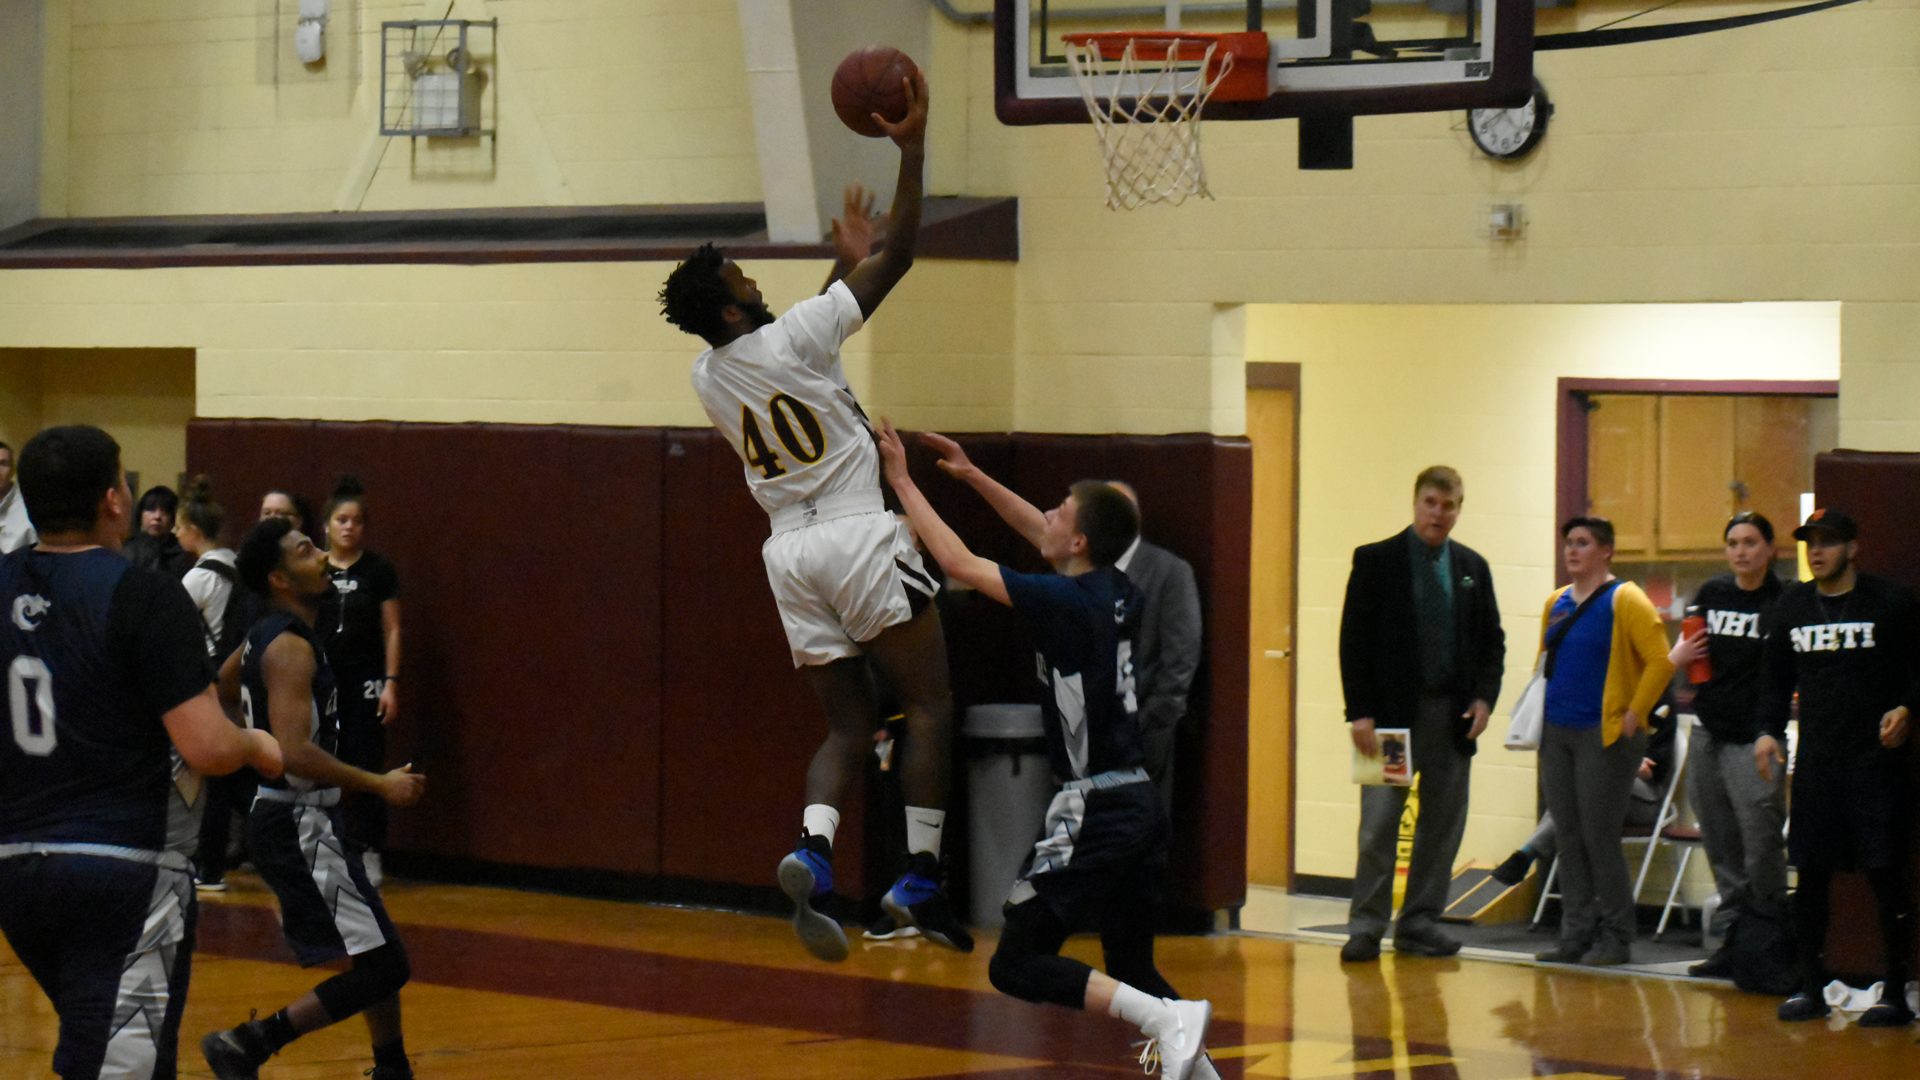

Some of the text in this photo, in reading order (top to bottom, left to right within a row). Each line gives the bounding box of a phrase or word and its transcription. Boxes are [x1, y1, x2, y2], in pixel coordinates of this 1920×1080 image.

[741, 392, 826, 481] 40
[1789, 621, 1876, 653] NHTI
[7, 654, 57, 757] 0
